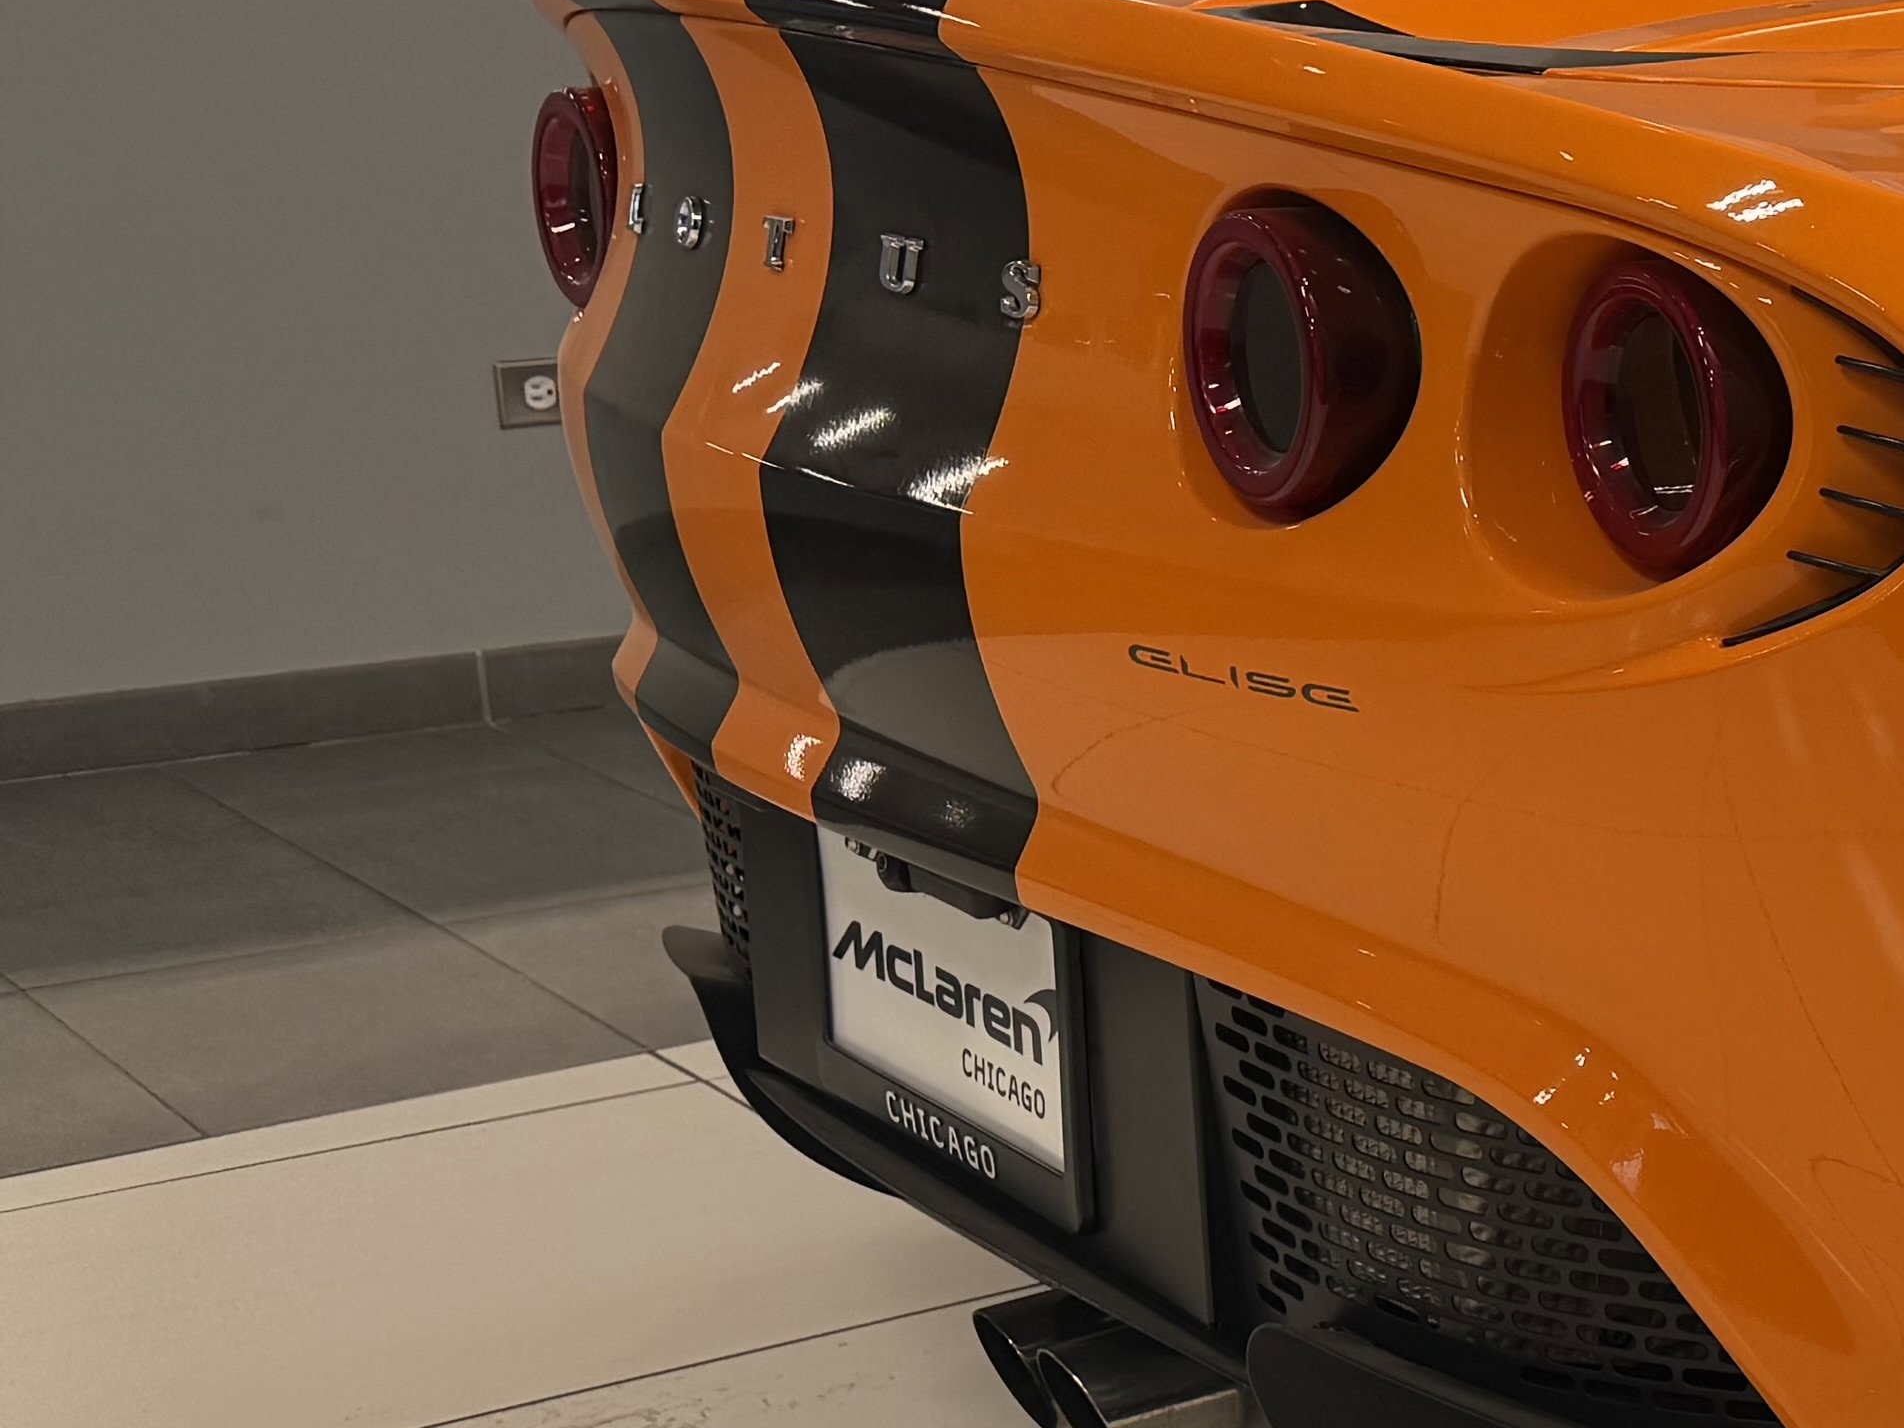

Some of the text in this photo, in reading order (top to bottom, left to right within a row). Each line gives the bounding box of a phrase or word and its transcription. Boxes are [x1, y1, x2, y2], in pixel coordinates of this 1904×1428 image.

[626, 182, 1042, 320] LOTUS
[1127, 643, 1361, 713] ELISE
[832, 920, 1044, 1066] McLaren
[961, 1047, 1047, 1120] CHICAGO
[884, 1089, 999, 1180] CHICAGO
